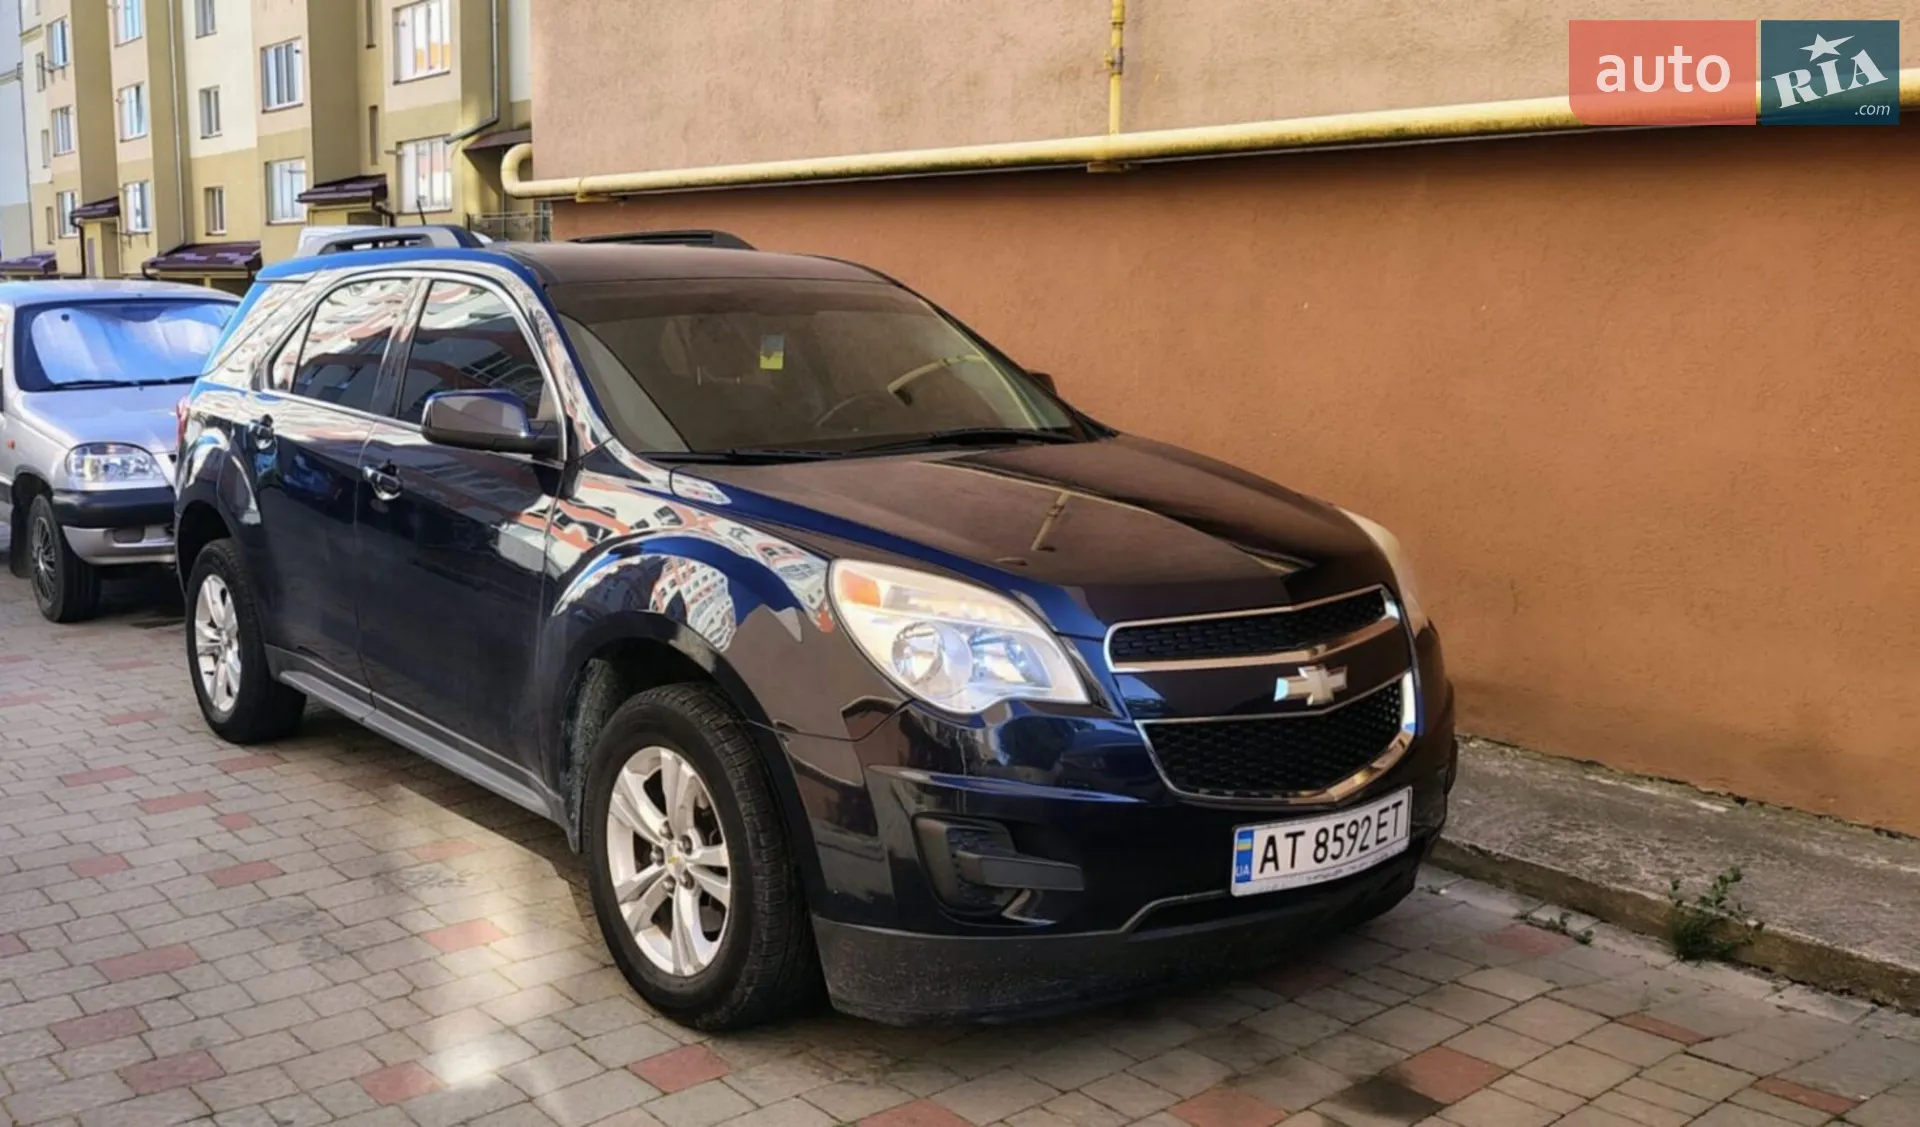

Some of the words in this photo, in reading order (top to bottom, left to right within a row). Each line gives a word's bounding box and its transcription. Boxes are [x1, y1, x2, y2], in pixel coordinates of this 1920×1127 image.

[1259, 831, 1305, 874] AT
[1313, 815, 1372, 864] 8592
[1376, 800, 1403, 845] ET
[1236, 865, 1250, 876] UA
